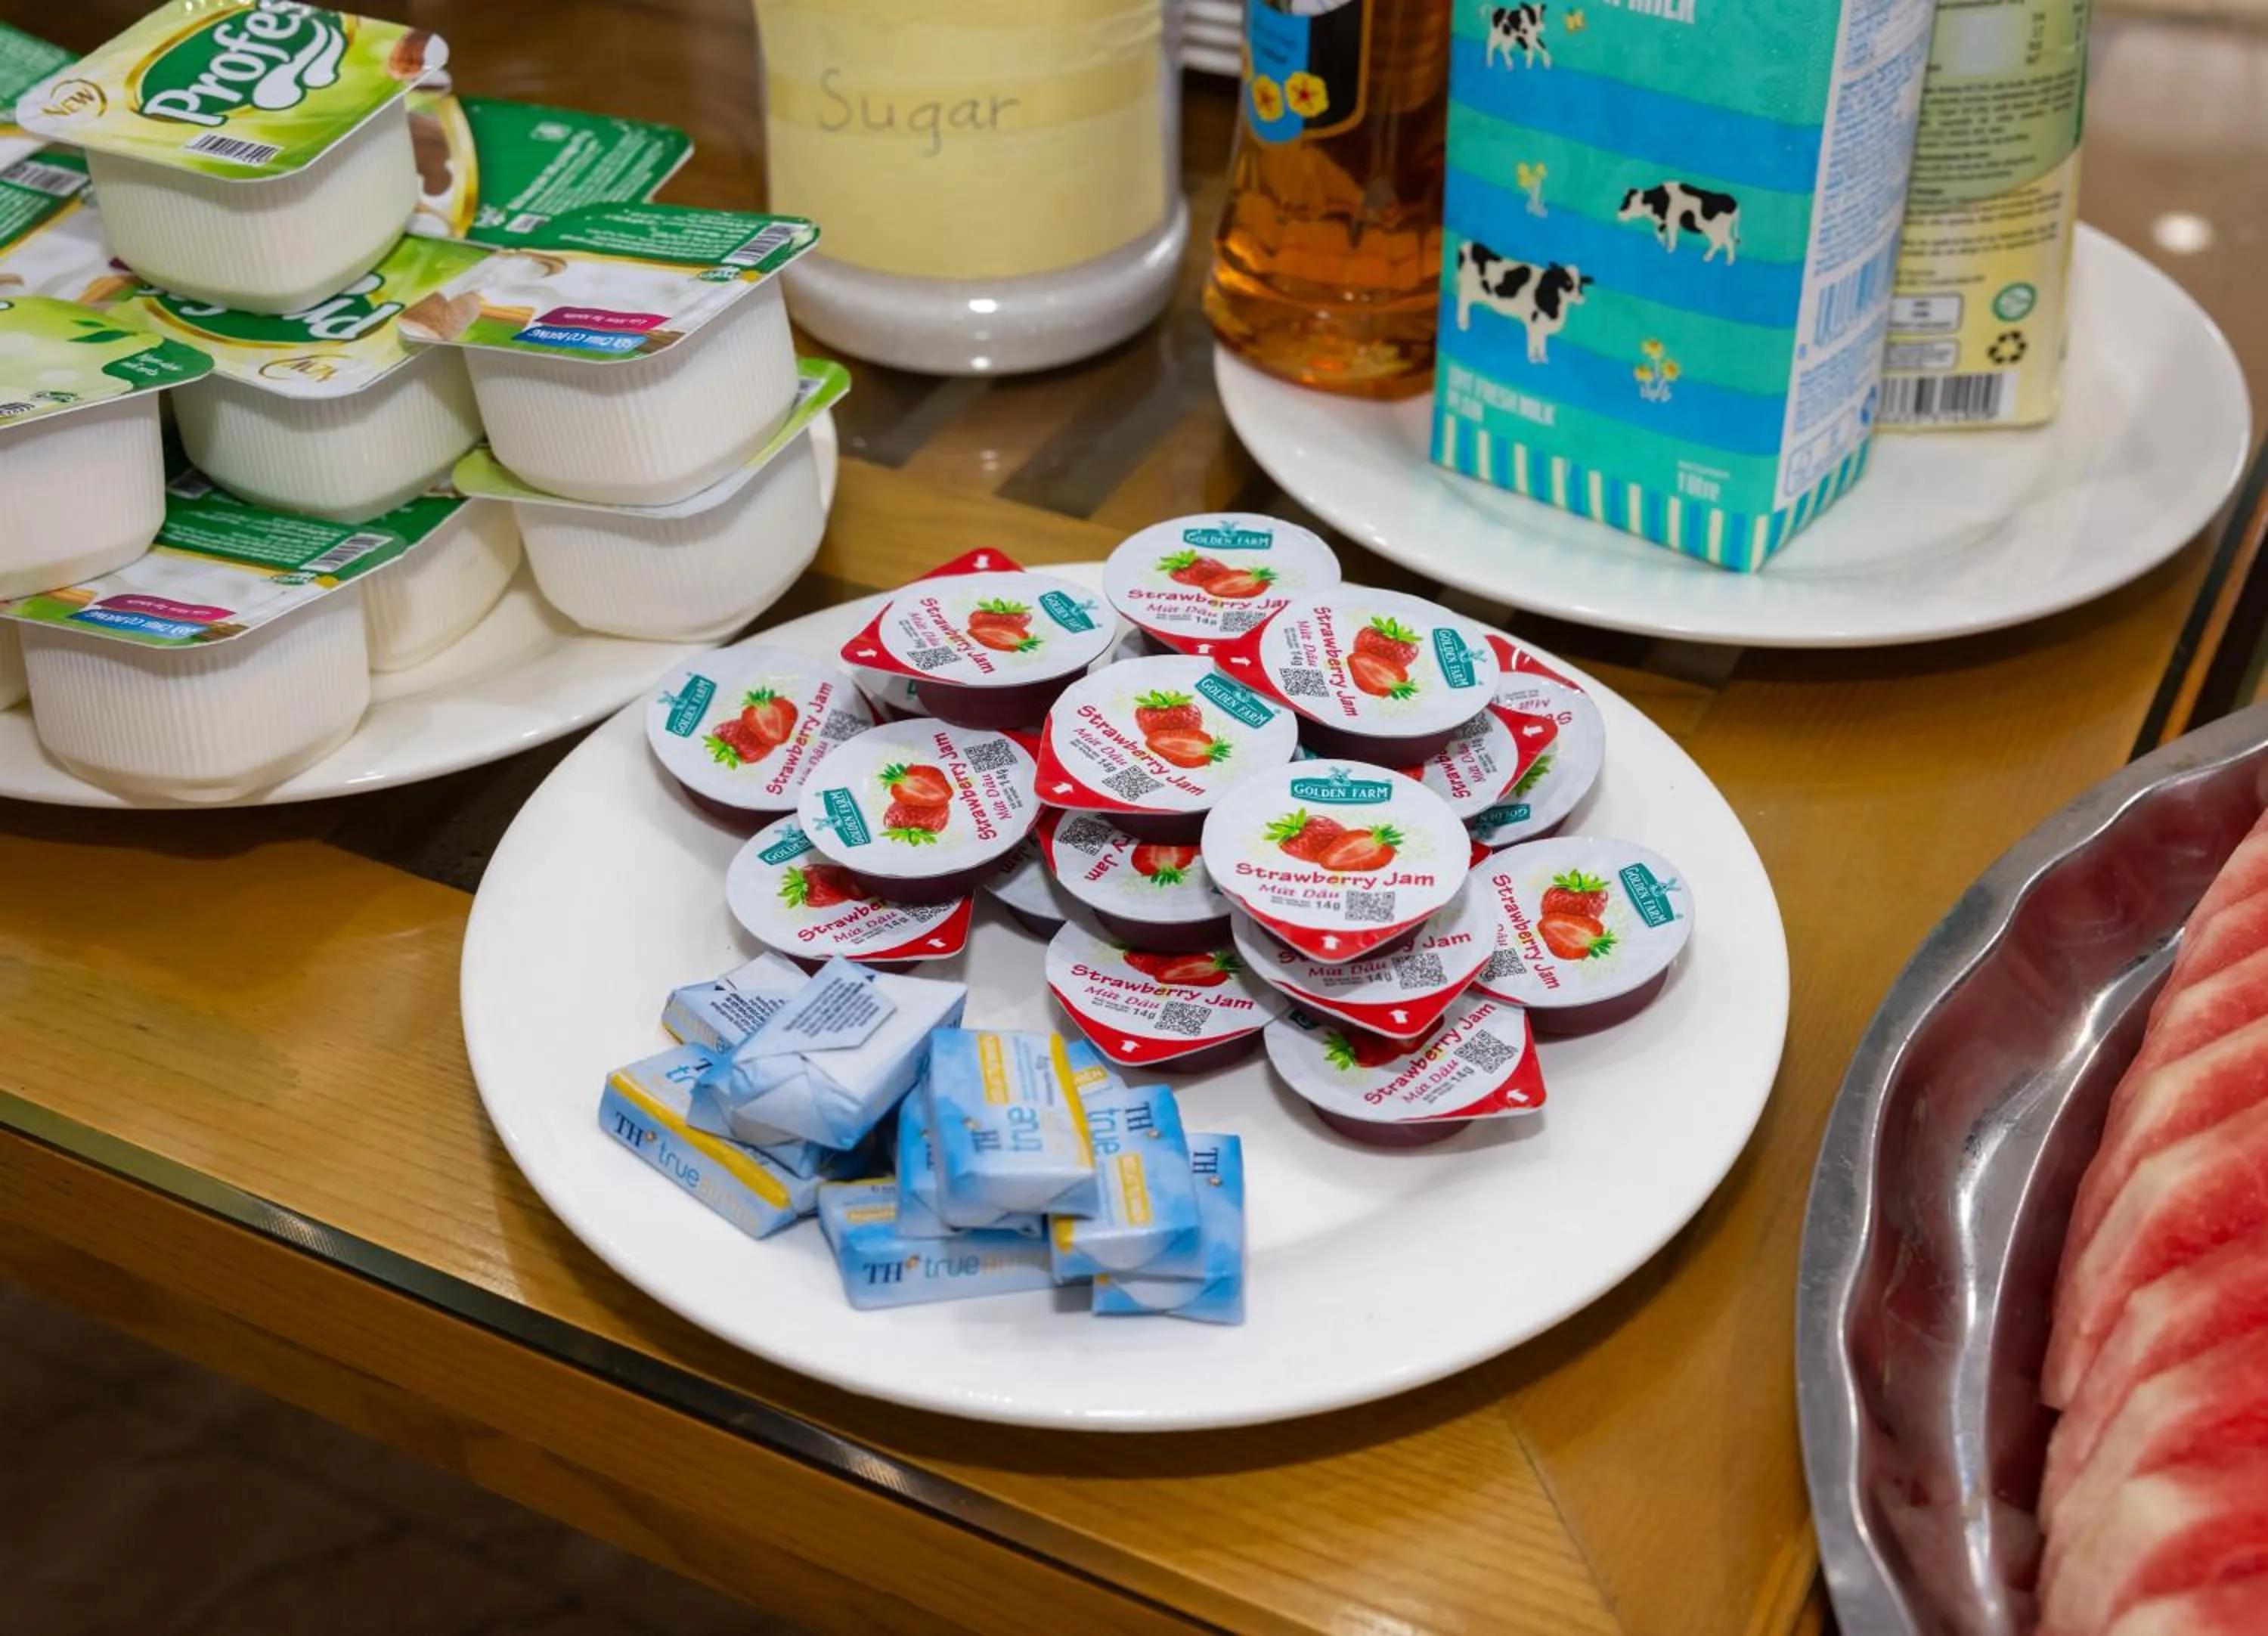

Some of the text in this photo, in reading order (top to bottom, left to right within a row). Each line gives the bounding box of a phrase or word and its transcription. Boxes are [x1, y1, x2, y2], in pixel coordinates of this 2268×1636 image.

[818, 68, 1021, 157] Sugar
[1185, 528, 1269, 547] GOLDEN FARM
[1127, 588, 1251, 610] Strawberry
[920, 597, 996, 674] Strawberry Jam
[1313, 606, 1359, 716] Strawberry Jam
[1439, 630, 1470, 687] GOLDEN FARM
[1201, 678, 1269, 726] GOLDEN FARM
[766, 681, 833, 795] Strawberry Jam
[1077, 704, 1206, 796] Strawberry Jam
[1098, 758, 1117, 773] 14g
[934, 732, 997, 840] Strawberry Jam
[1294, 783, 1390, 798] GOLDEN FARM
[765, 835, 809, 863] GOLDEN
[1084, 853, 1119, 882] Jam
[1235, 863, 1435, 890] Strawberry Jam
[1625, 866, 1667, 925] GOLDEN FARM
[798, 897, 887, 942] Strawbe
[1315, 900, 1341, 910] 14g
[1421, 932, 1471, 949] Jam
[1492, 874, 1560, 989] Strawberry Jam
[1070, 964, 1254, 1010] Strawberry Jam
[1133, 1008, 1156, 1021] 14g
[1364, 1002, 1496, 1105] Strawberry Jam
[1451, 1065, 1475, 1083] 14g
[1125, 1101, 1154, 1132] TH
[615, 1111, 701, 1189] TH true
[1192, 1146, 1219, 1174] TH
[863, 1260, 904, 1284] TH
[924, 1254, 980, 1279] true
